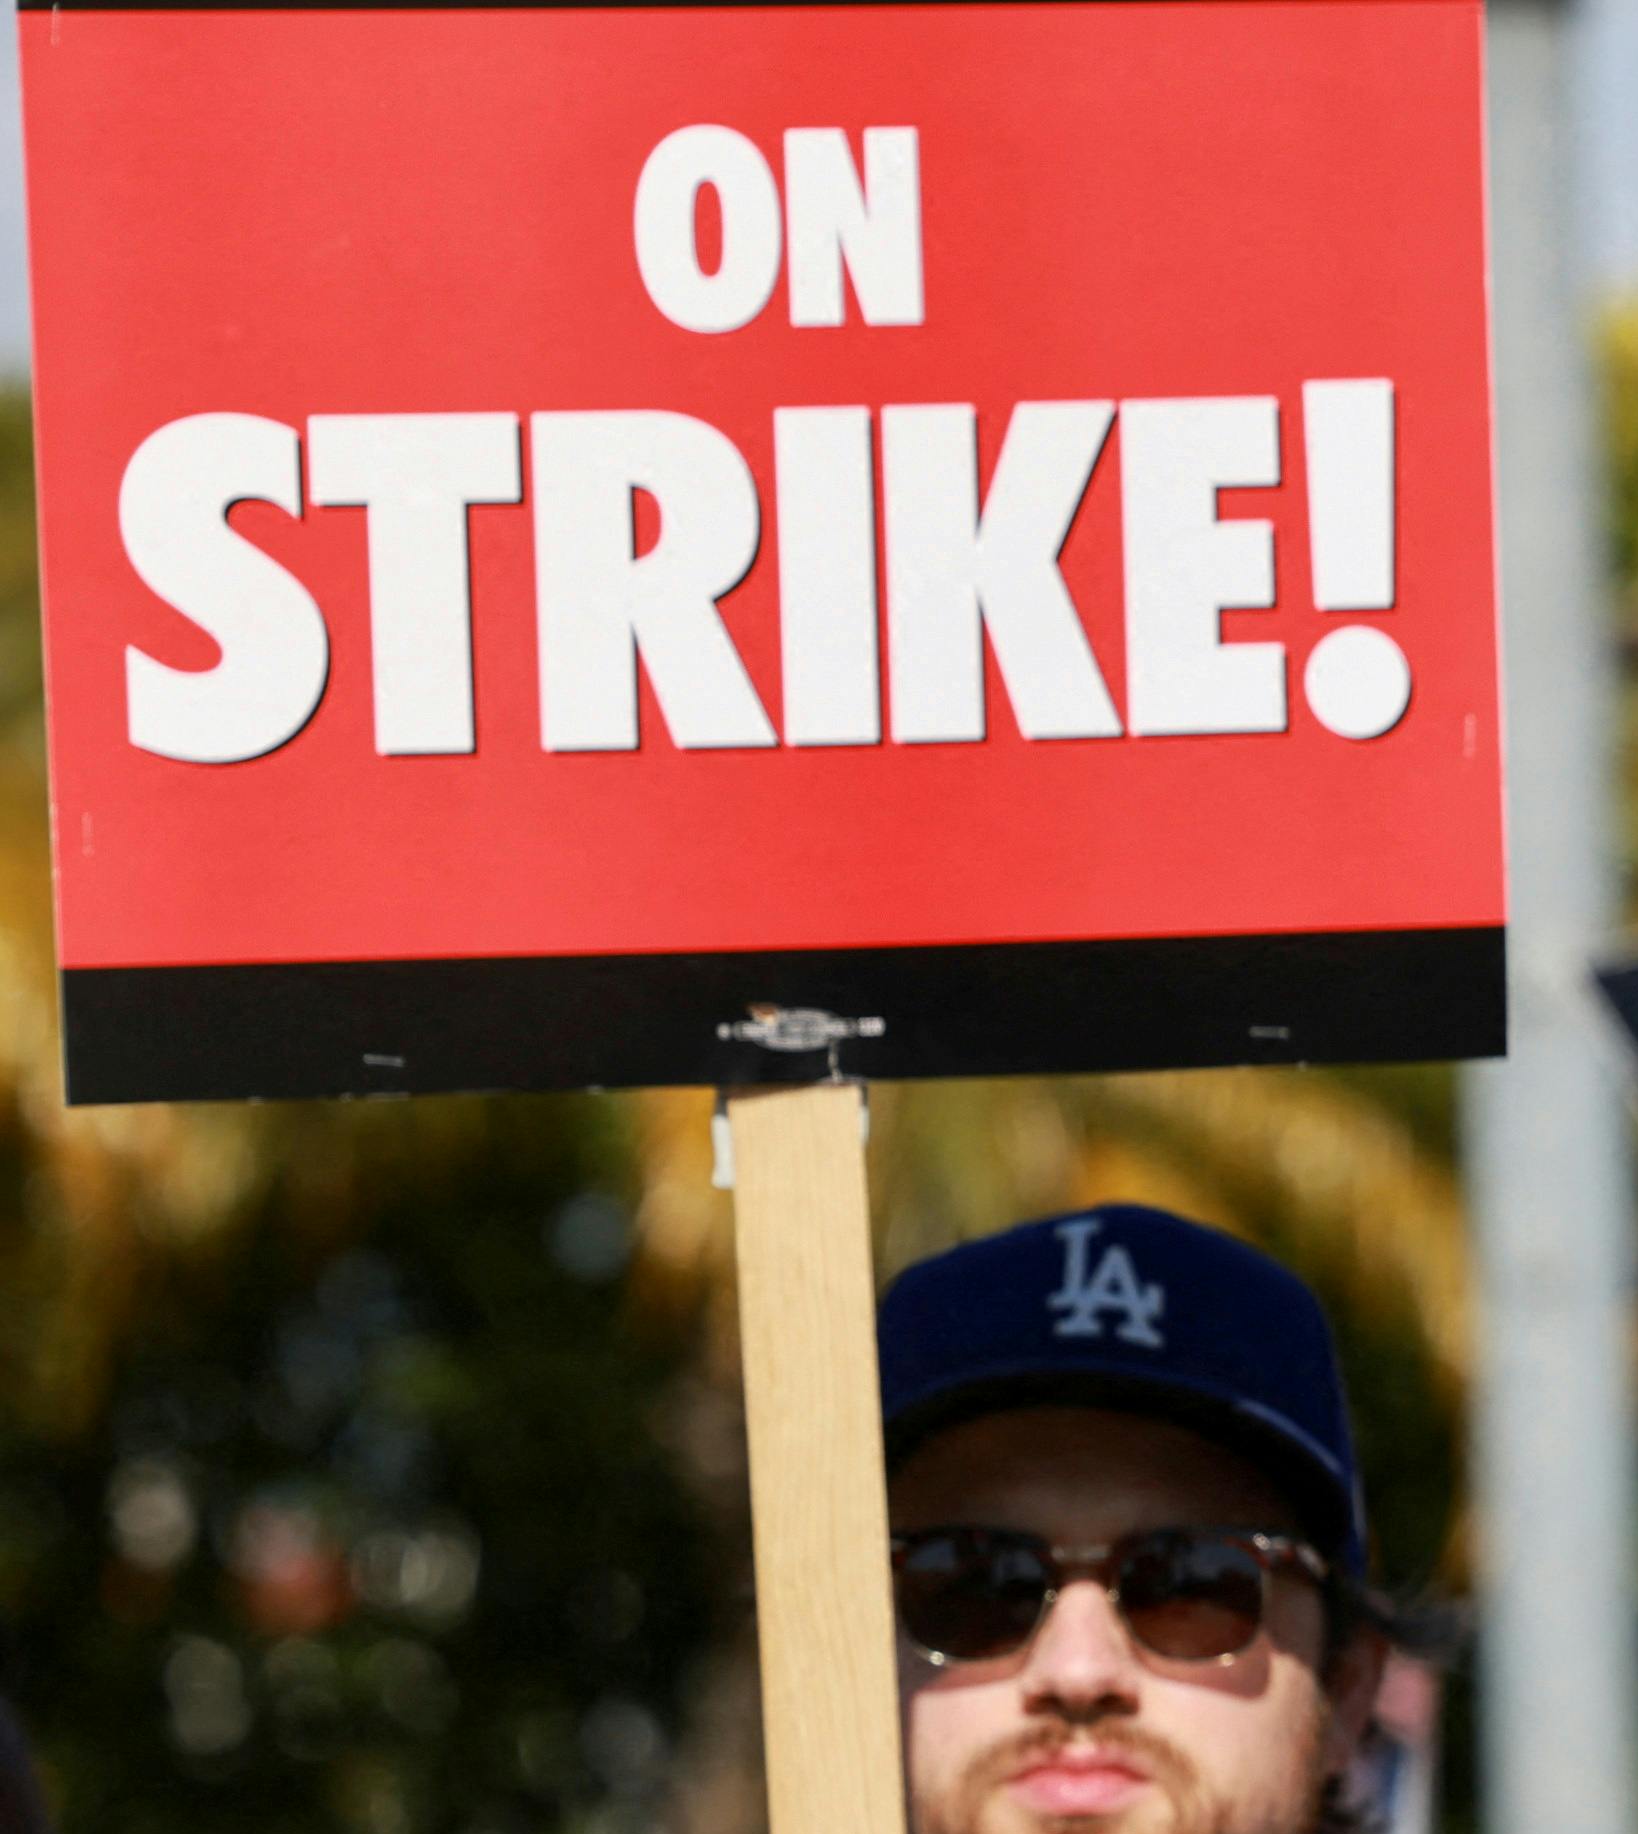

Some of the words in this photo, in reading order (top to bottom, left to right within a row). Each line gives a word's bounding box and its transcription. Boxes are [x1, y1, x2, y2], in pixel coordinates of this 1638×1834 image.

[633, 122, 925, 334] ON
[118, 378, 1412, 763] STRIKE!
[1046, 1219, 1164, 1347] LA
